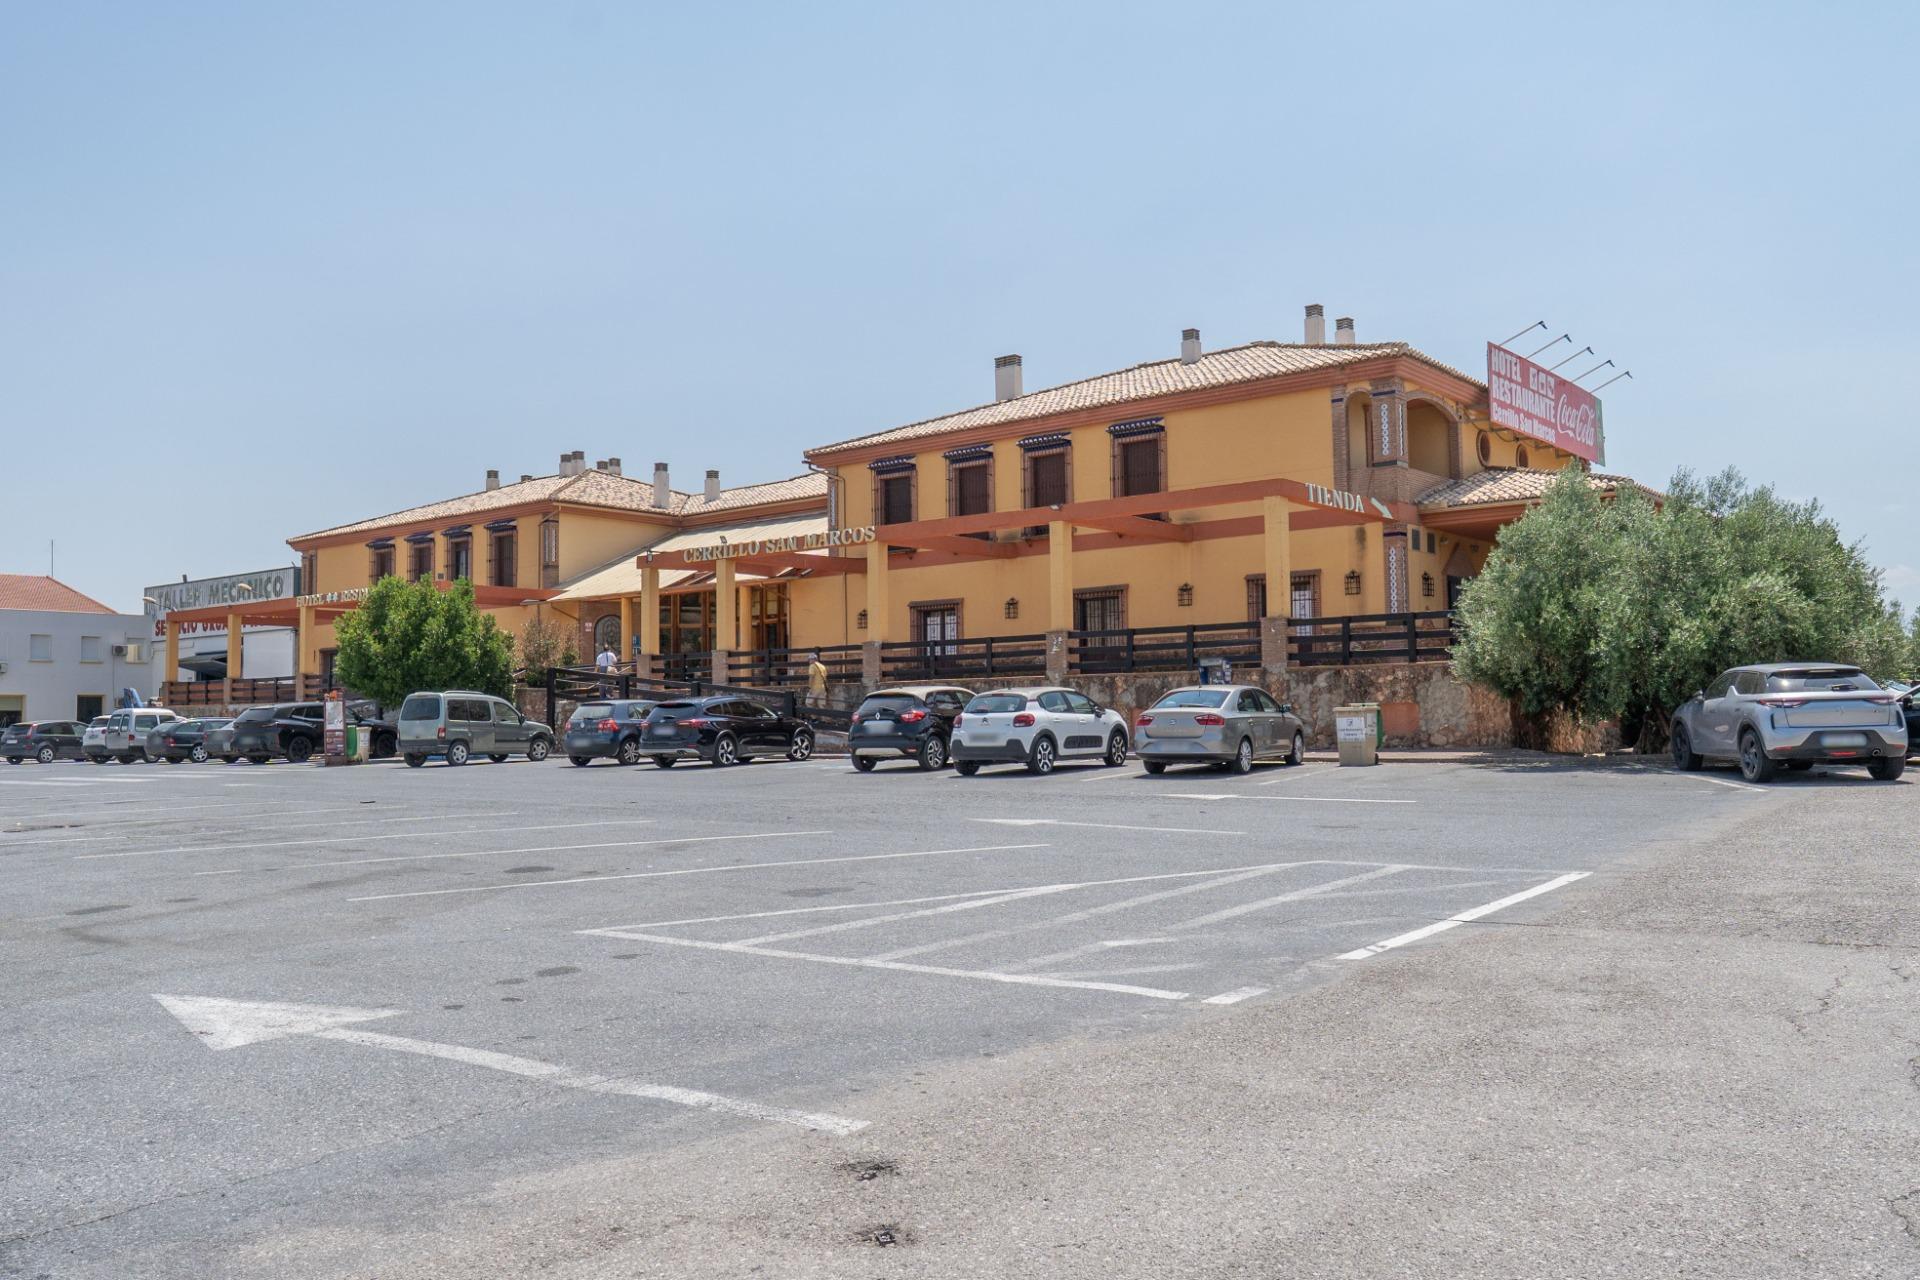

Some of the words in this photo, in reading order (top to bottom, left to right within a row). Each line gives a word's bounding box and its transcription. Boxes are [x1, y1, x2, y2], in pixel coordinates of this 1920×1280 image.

[1491, 347, 1522, 382] HOTEL
[1492, 374, 1555, 424] RESTAURANTE
[1305, 482, 1365, 513] TIENDA
[683, 540, 760, 563] CERRILLO
[765, 536, 798, 555] SAN
[803, 526, 876, 549] MARCOS
